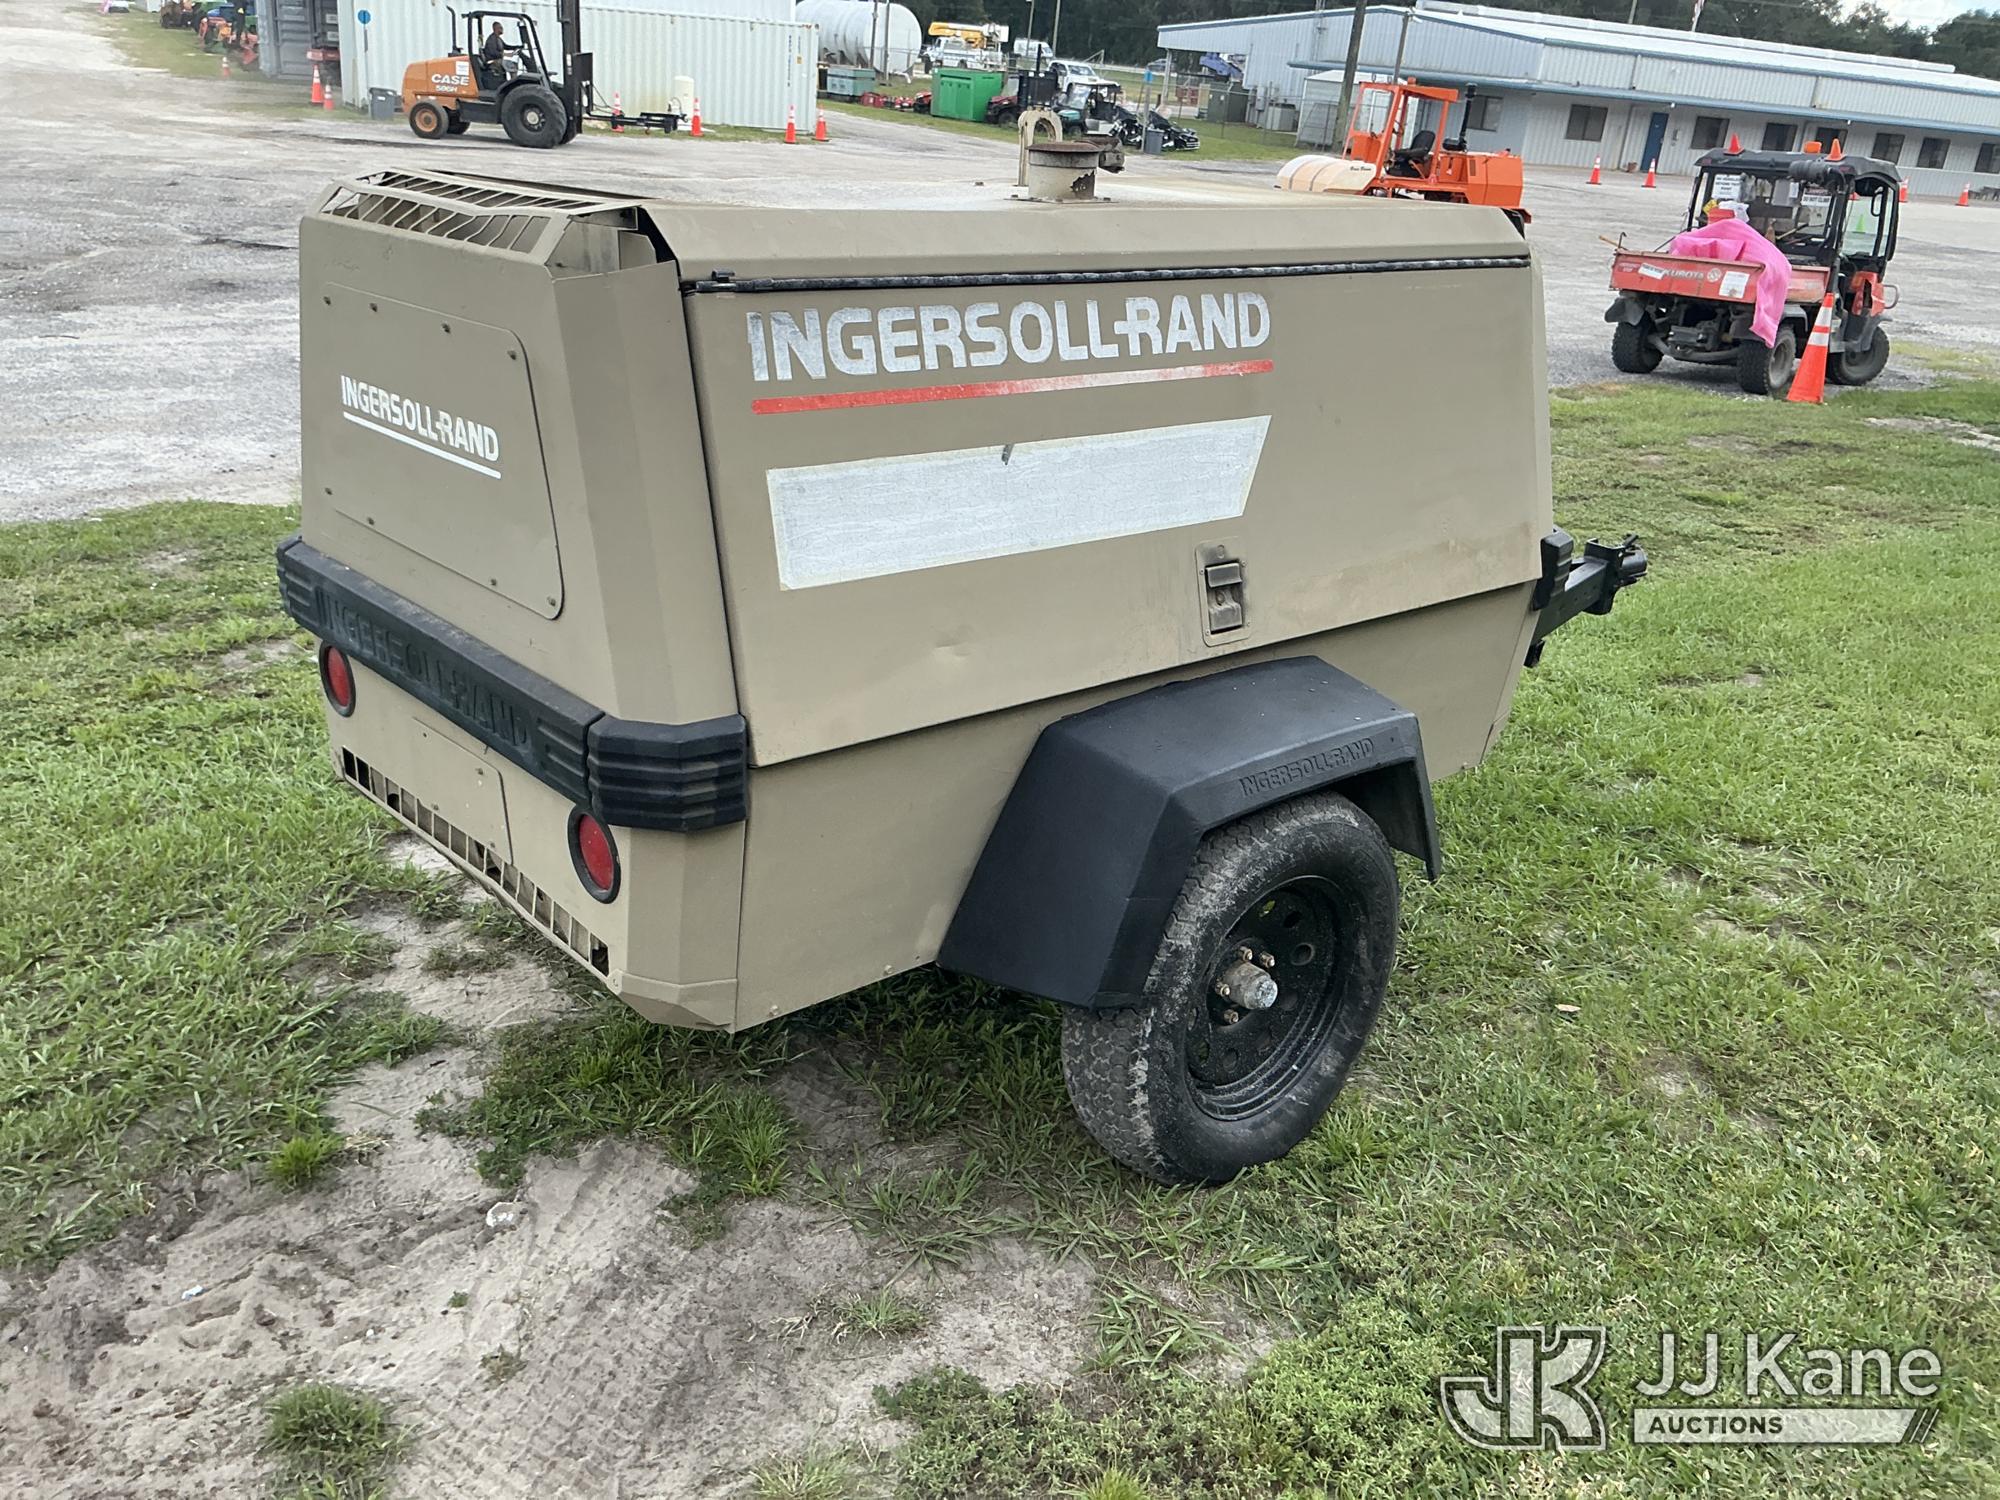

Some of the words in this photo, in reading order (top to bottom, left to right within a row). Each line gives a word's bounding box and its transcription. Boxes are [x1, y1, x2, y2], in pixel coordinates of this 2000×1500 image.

[431, 73, 470, 86] CASE
[746, 292, 1271, 382] INGERSOLL-RAND
[340, 374, 499, 462] INGERSOLL-RAND
